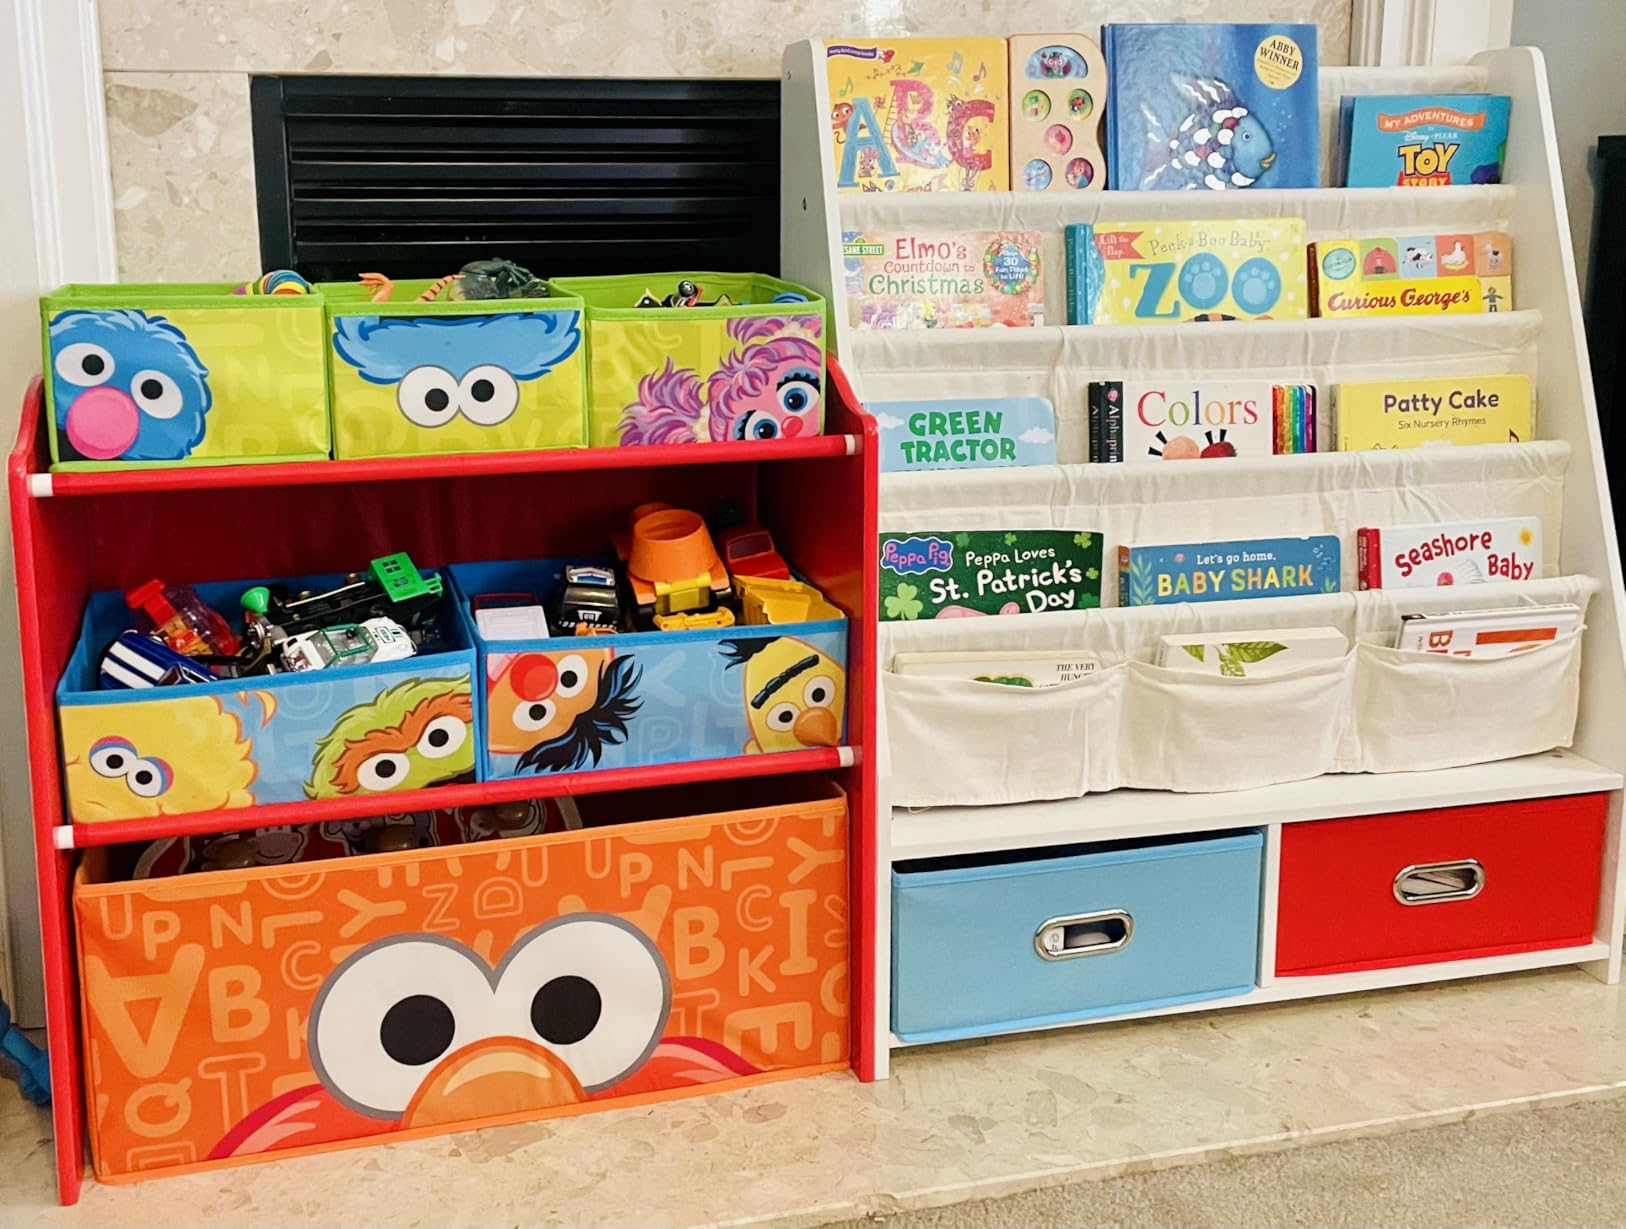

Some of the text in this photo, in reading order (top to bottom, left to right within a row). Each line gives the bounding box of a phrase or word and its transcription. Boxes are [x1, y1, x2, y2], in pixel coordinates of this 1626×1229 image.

[1260, 46, 1299, 71] WINNER
[1269, 40, 1296, 56] ABBY
[1384, 111, 1474, 129] MY ADVENTURES
[1397, 142, 1461, 176] TOY
[862, 245, 883, 254] STREET
[895, 237, 967, 261] Elmo's
[1100, 234, 1117, 245] Lift
[884, 258, 976, 274] Countdown to
[1003, 256, 1019, 266] 30
[868, 273, 985, 295] Christmas
[1129, 251, 1282, 319] ZOO
[1327, 288, 1471, 312] Curious George's
[1137, 389, 1259, 427] Colors
[1384, 389, 1500, 416] Patty Cake
[908, 410, 1003, 437] GREEN
[1398, 416, 1487, 430] Six Nursery Rhymes
[900, 437, 1017, 464] TRACTOR
[884, 541, 951, 570] Peppa Pig
[965, 547, 1056, 569] Peppa Loves
[1196, 551, 1277, 566] Let's go home.
[1394, 531, 1493, 578] Seashore
[1487, 552, 1534, 580] Baby
[929, 577, 970, 604] St.
[976, 560, 1083, 597] Patrick's
[1157, 569, 1226, 597] BABY
[1231, 564, 1314, 592] SHARK
[1025, 589, 1076, 614] Day
[1055, 663, 1073, 671] THE
